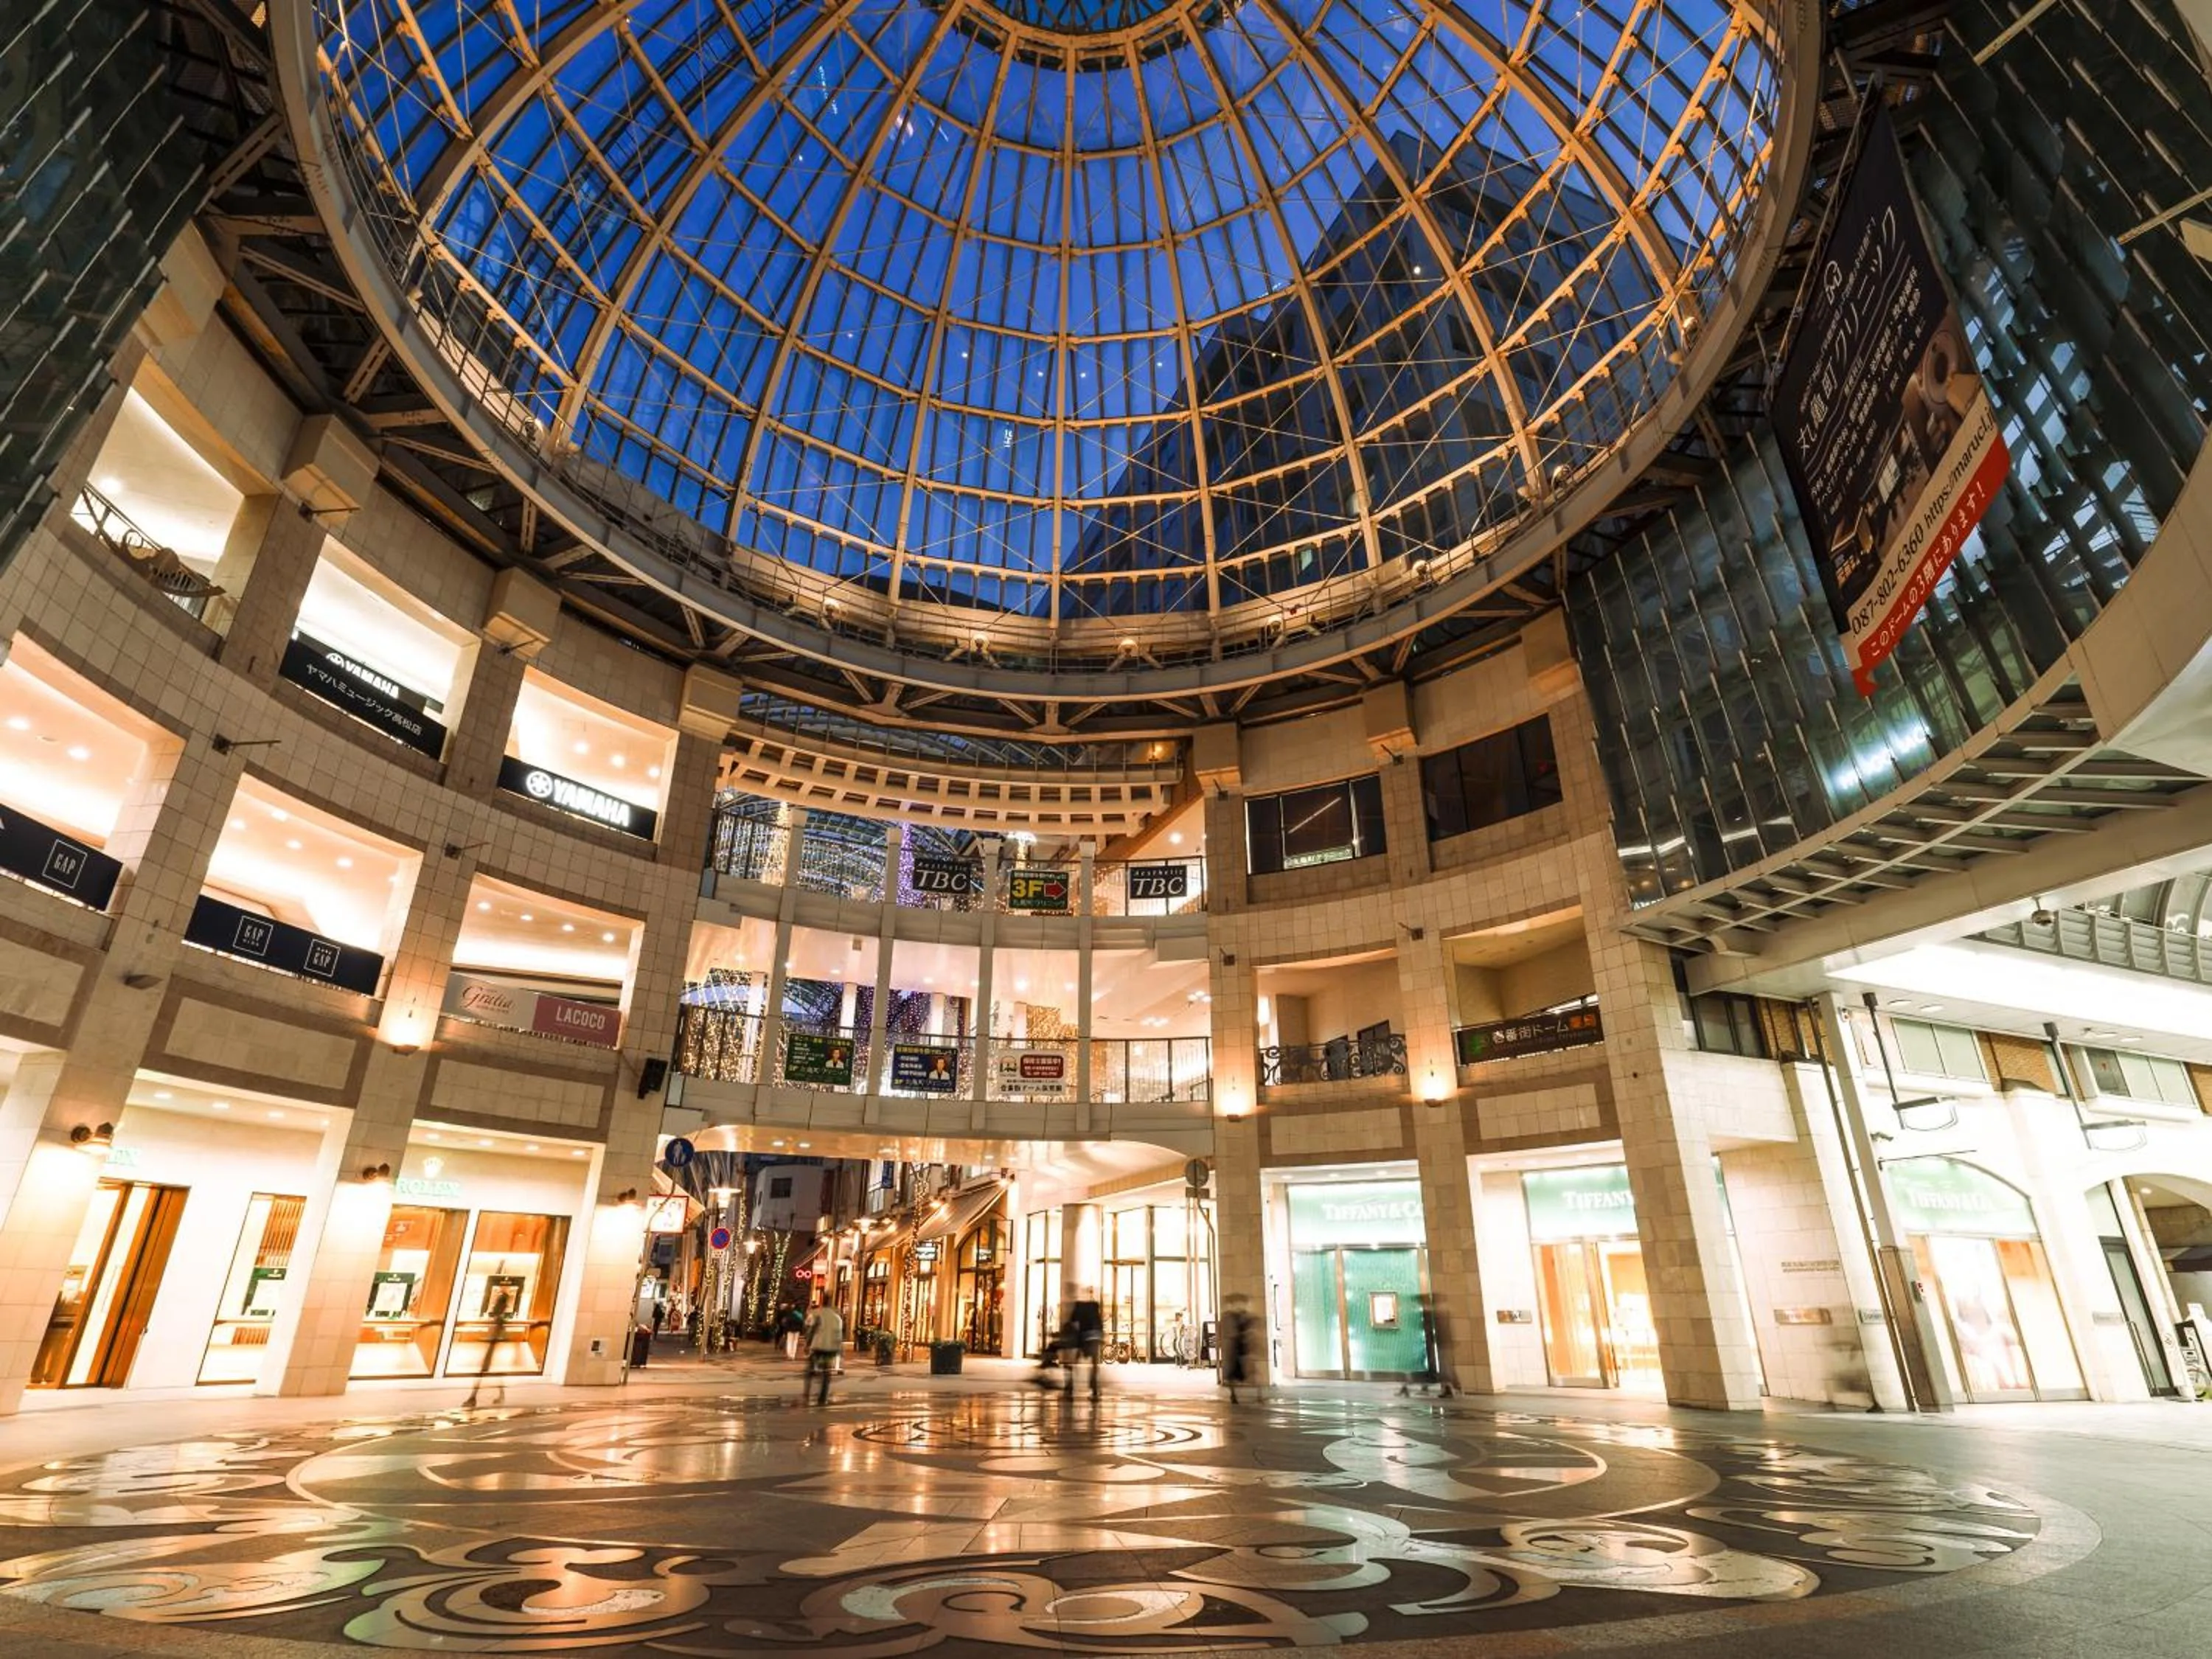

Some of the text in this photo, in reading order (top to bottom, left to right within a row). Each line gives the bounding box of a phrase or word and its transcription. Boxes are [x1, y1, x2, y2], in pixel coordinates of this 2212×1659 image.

[345, 661, 399, 698] YAMAHA
[307, 663, 422, 737] ヤマハミュージック高松店
[554, 779, 630, 827] YAMAHA
[54, 853, 76, 875] GAP
[916, 869, 967, 891] TBC
[1012, 878, 1044, 898] 3F
[1133, 877, 1183, 896] TBC
[244, 924, 265, 942] GAP
[313, 951, 331, 968] GAP
[556, 1005, 606, 1030] LACOCO
